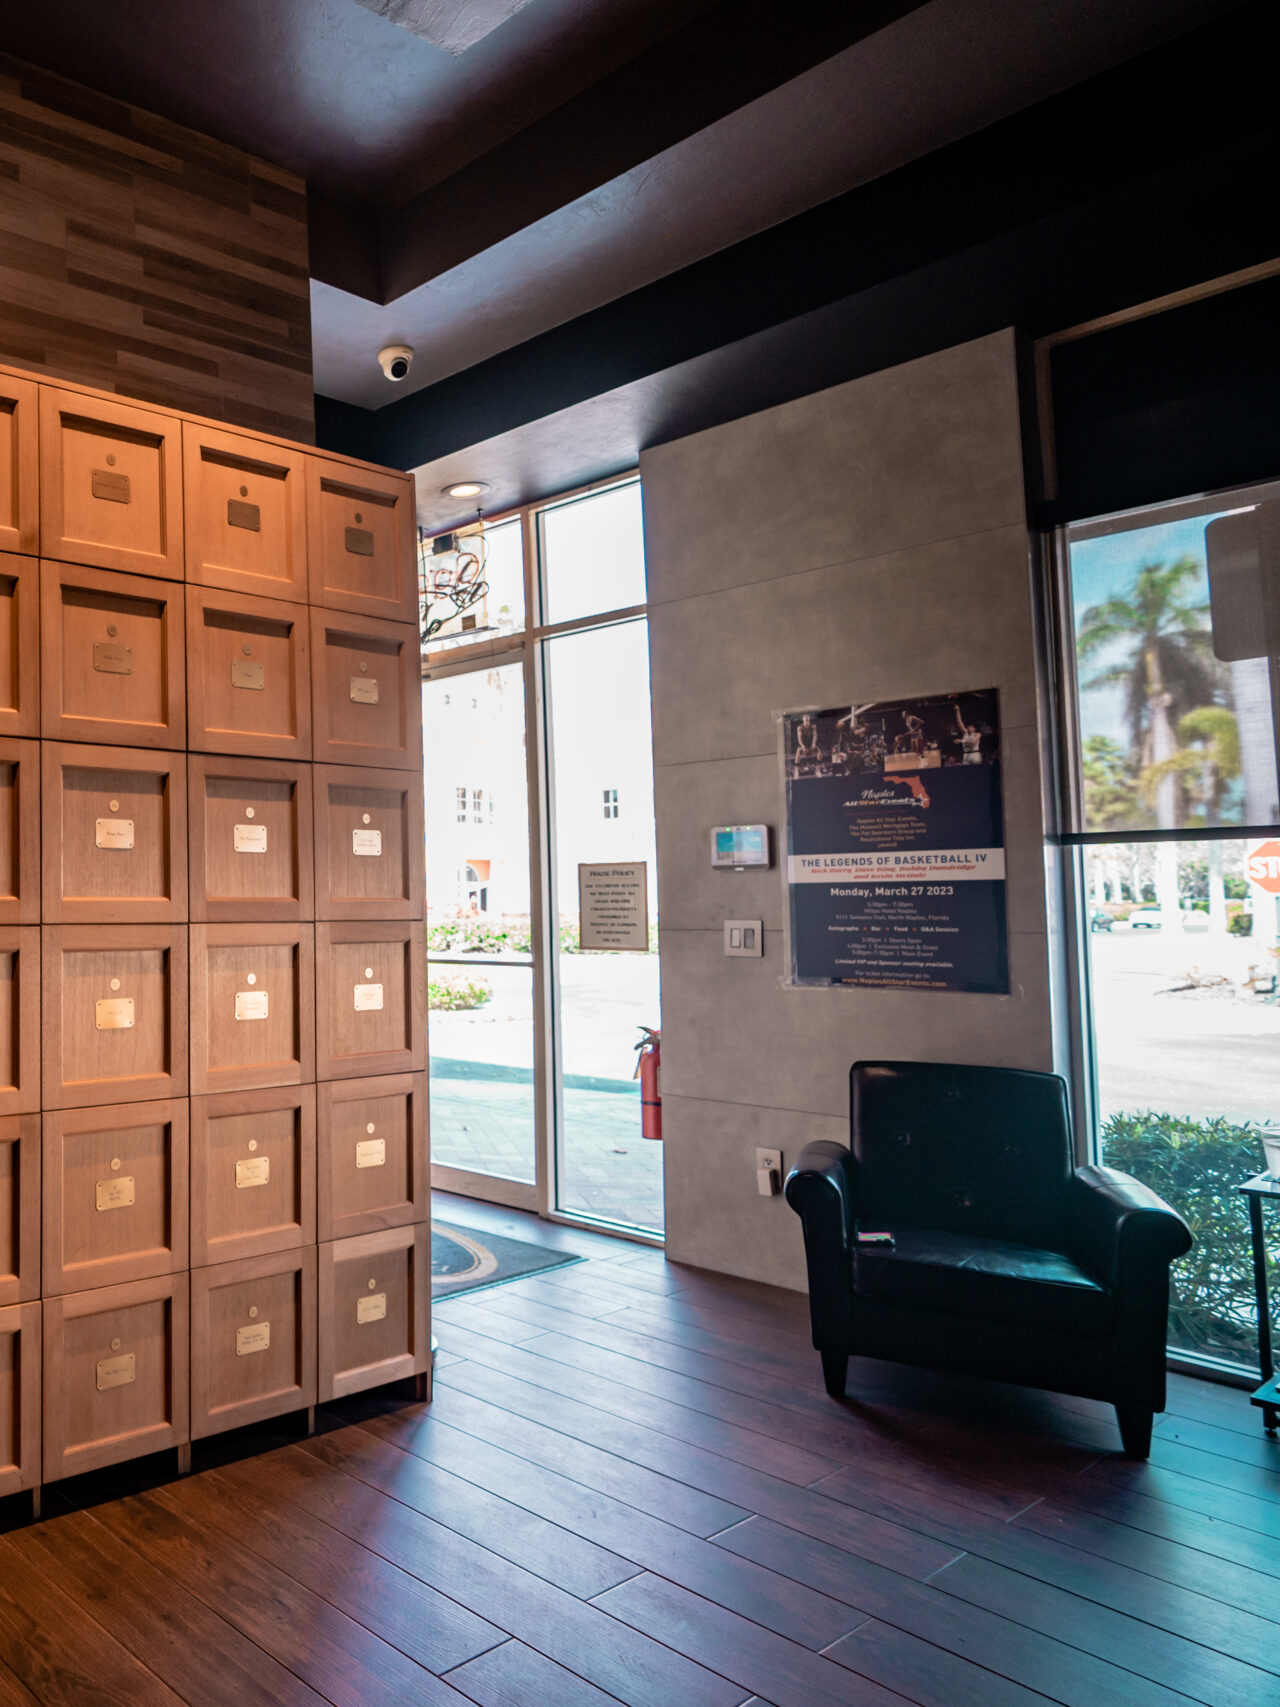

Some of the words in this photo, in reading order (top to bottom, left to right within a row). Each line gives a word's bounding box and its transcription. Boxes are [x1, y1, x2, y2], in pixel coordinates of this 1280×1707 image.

[861, 789, 896, 800] Naples
[801, 859, 821, 868] THE
[824, 857, 873, 867] LEGENDS
[876, 857, 891, 865] OF
[894, 854, 972, 865] BASKETBALL
[975, 853, 988, 863] IV
[1249, 856, 1280, 880] ST
[830, 886, 873, 898] Monday,
[875, 886, 907, 896] March
[910, 886, 925, 896] 27
[927, 885, 954, 896] 2023
